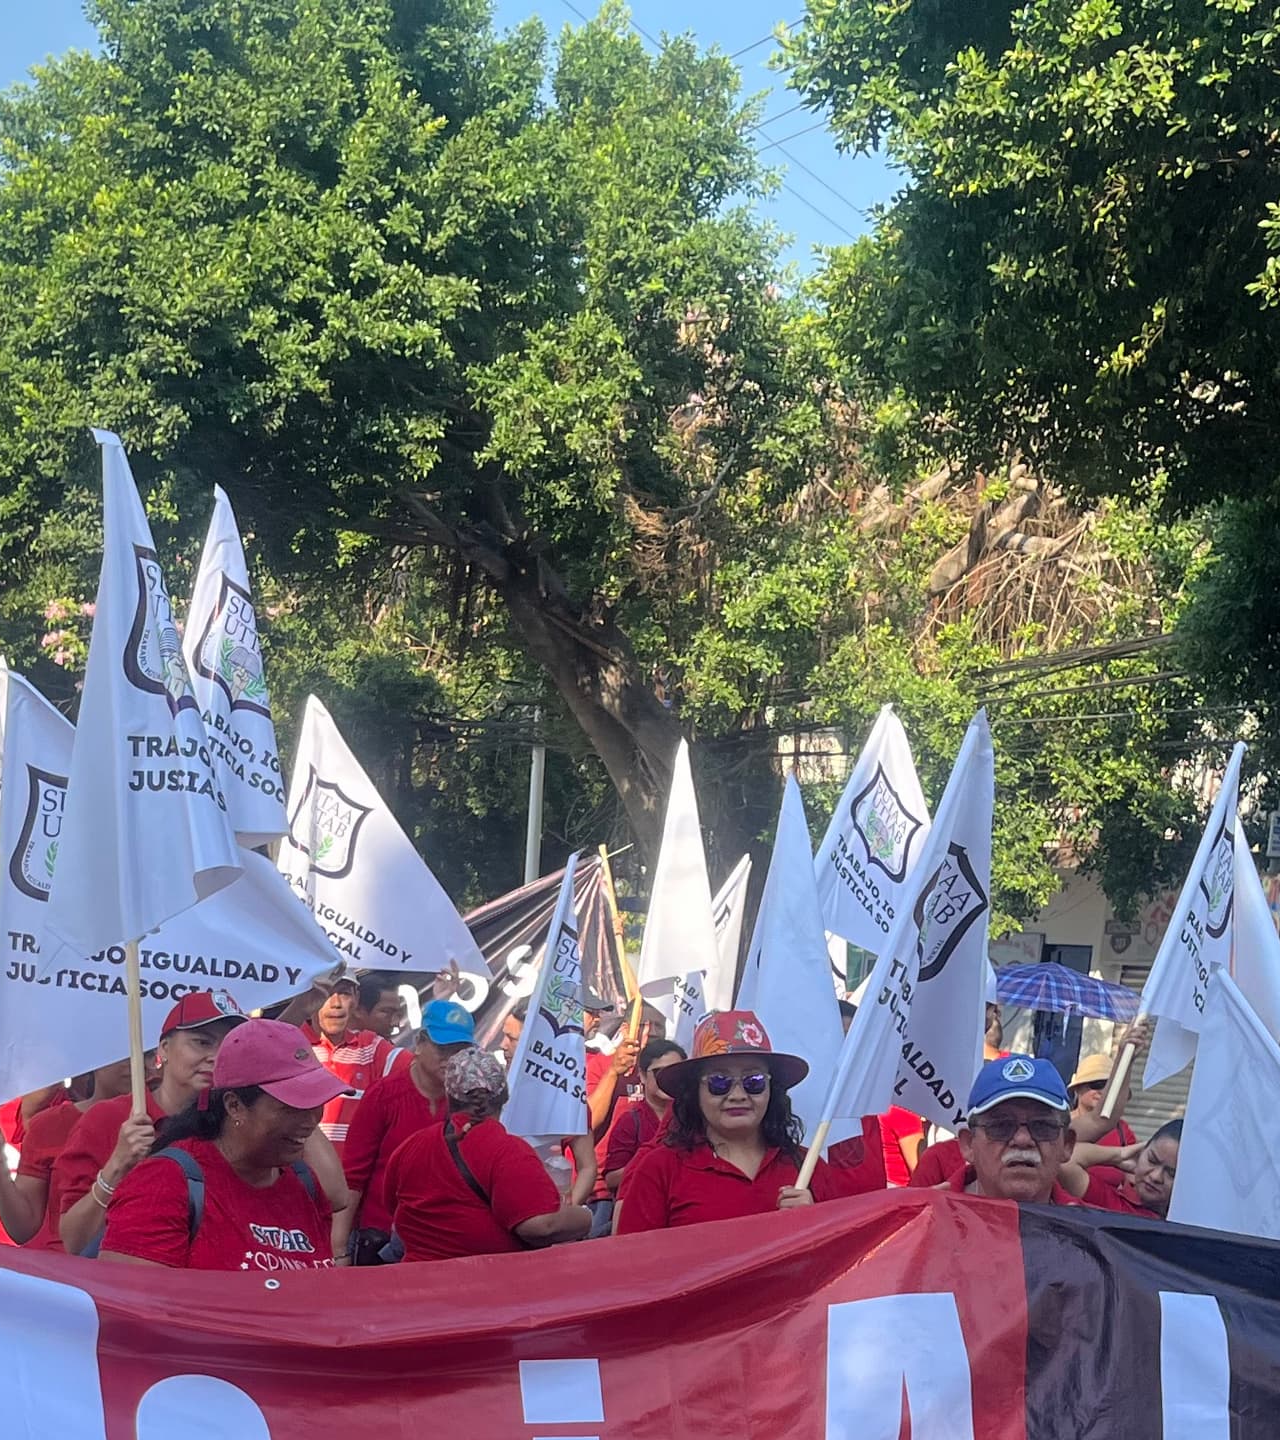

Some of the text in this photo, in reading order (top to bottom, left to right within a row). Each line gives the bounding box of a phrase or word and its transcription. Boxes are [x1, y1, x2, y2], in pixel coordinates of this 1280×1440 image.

[830, 850, 874, 918] JUSTICIA
[838, 834, 880, 906] TRABAJO,
[317, 904, 399, 958] IGUALDAD
[400, 950, 413, 964] Y
[140, 950, 280, 983] IGUALDAD
[284, 967, 303, 986] Y
[249, 1222, 316, 1254] STAR
